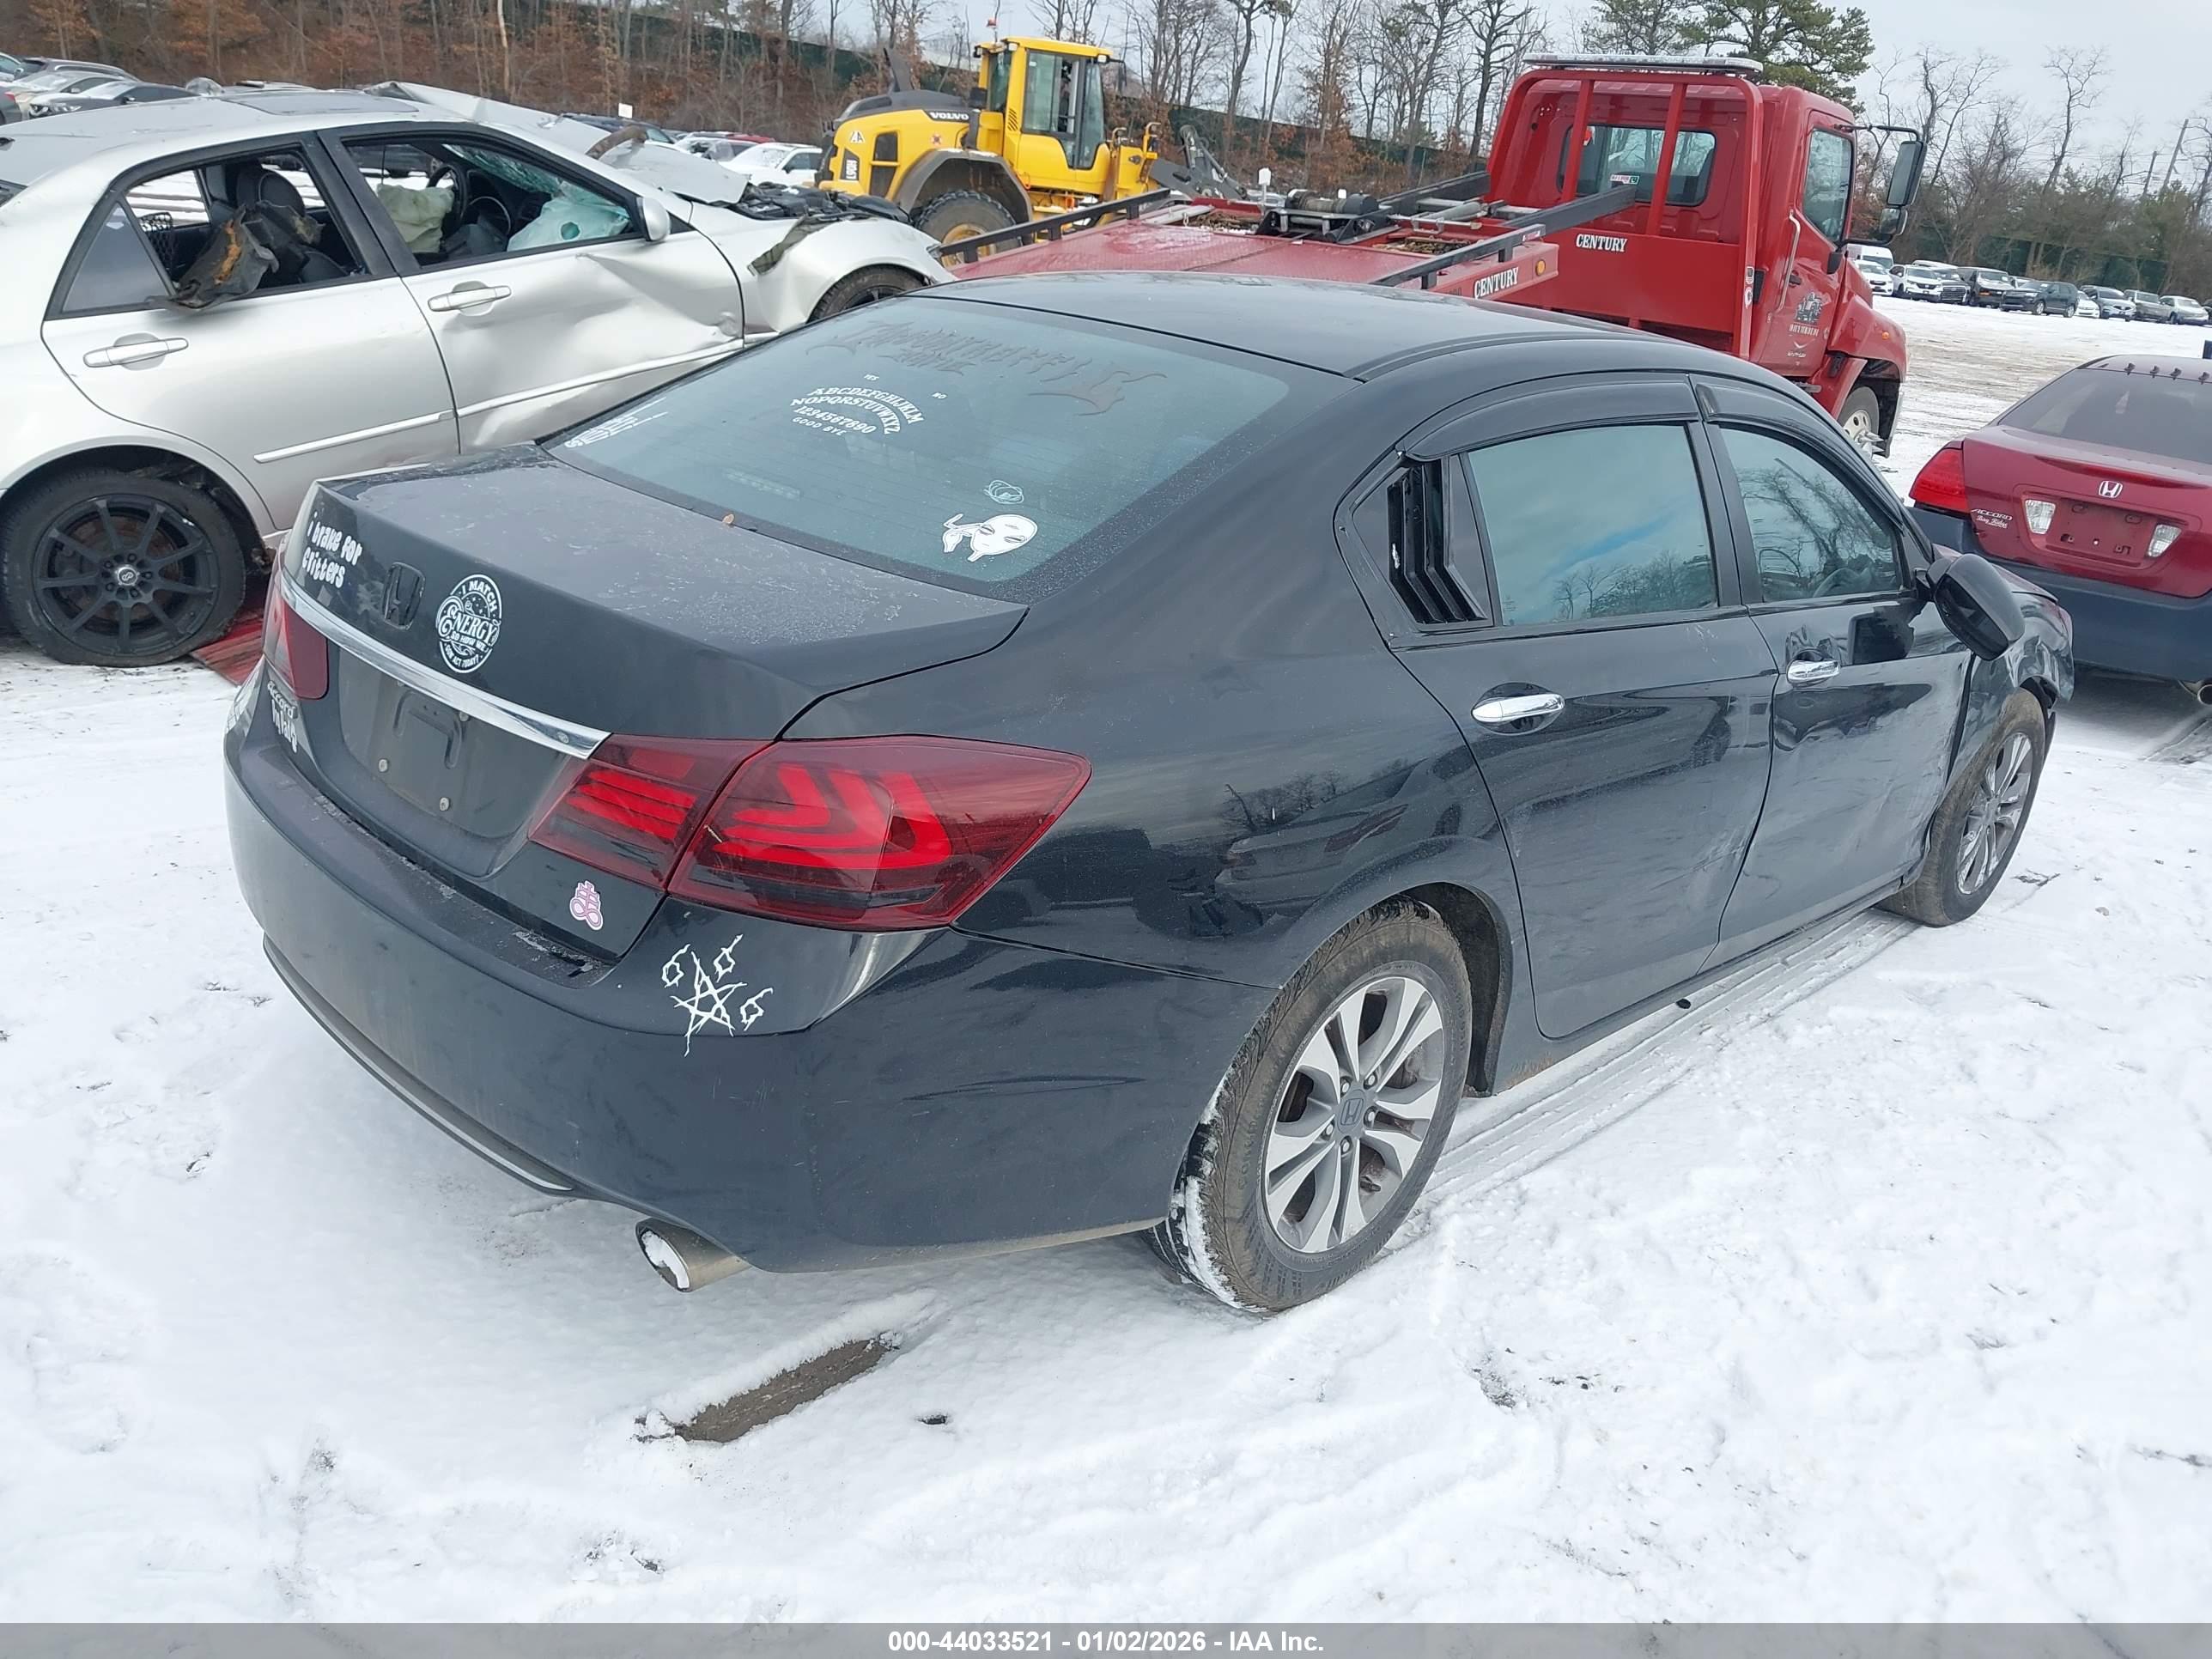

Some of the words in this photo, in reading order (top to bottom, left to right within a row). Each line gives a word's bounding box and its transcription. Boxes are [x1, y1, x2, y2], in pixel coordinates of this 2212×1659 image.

[930, 112, 969, 120] VOLVO
[1576, 234, 1628, 252] CENTURY
[1474, 266, 1519, 300] CENTURY
[790, 396, 901, 434] NOPQRSTUVWXYZ
[793, 405, 877, 434] 1234567890
[806, 387, 925, 424] ABCDEFGHIJKLM
[793, 416, 822, 428] GOOD
[823, 425, 848, 436] BYE
[1971, 508, 2013, 521] ACCORD
[312, 521, 343, 552] brake
[340, 535, 363, 566] for
[302, 546, 346, 588] critters
[461, 585, 466, 595] I
[468, 580, 498, 612] MATCH
[438, 604, 499, 644] ENERGY
[450, 630, 460, 641] SO
